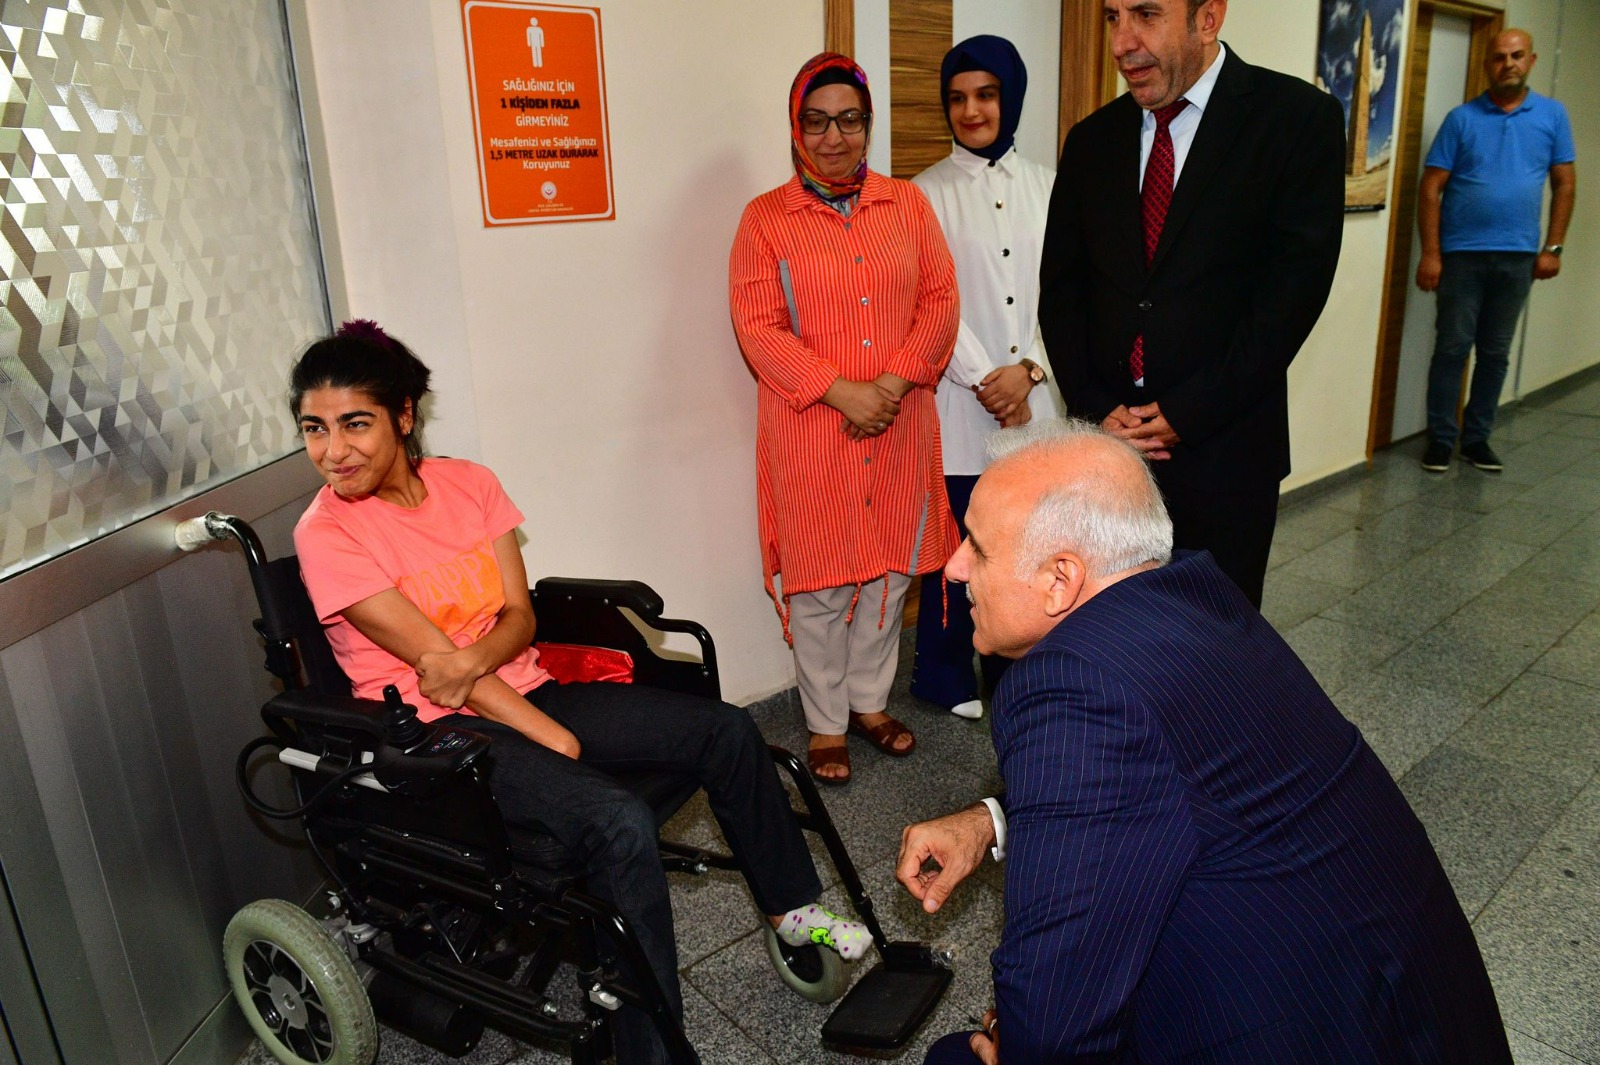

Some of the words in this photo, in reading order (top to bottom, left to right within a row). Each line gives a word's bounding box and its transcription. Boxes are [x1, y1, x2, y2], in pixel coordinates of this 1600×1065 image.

[503, 78, 554, 91] SAĞLIĞINIZ
[556, 79, 575, 94] İÇİN
[500, 98, 507, 109] 1
[510, 96, 548, 112] KİŞİDEN
[551, 99, 580, 109] FAZLA
[515, 114, 569, 127] GİRMEYİNİZ
[490, 137, 538, 147] Mesafenizi
[540, 139, 551, 147] ve
[553, 137, 596, 149] Sağlığınızı
[490, 150, 503, 161] 1,5
[506, 151, 534, 160] METRE
[537, 150, 557, 159] UZAK
[560, 149, 598, 158] DURARAK
[523, 160, 570, 171] Koruyunuz
